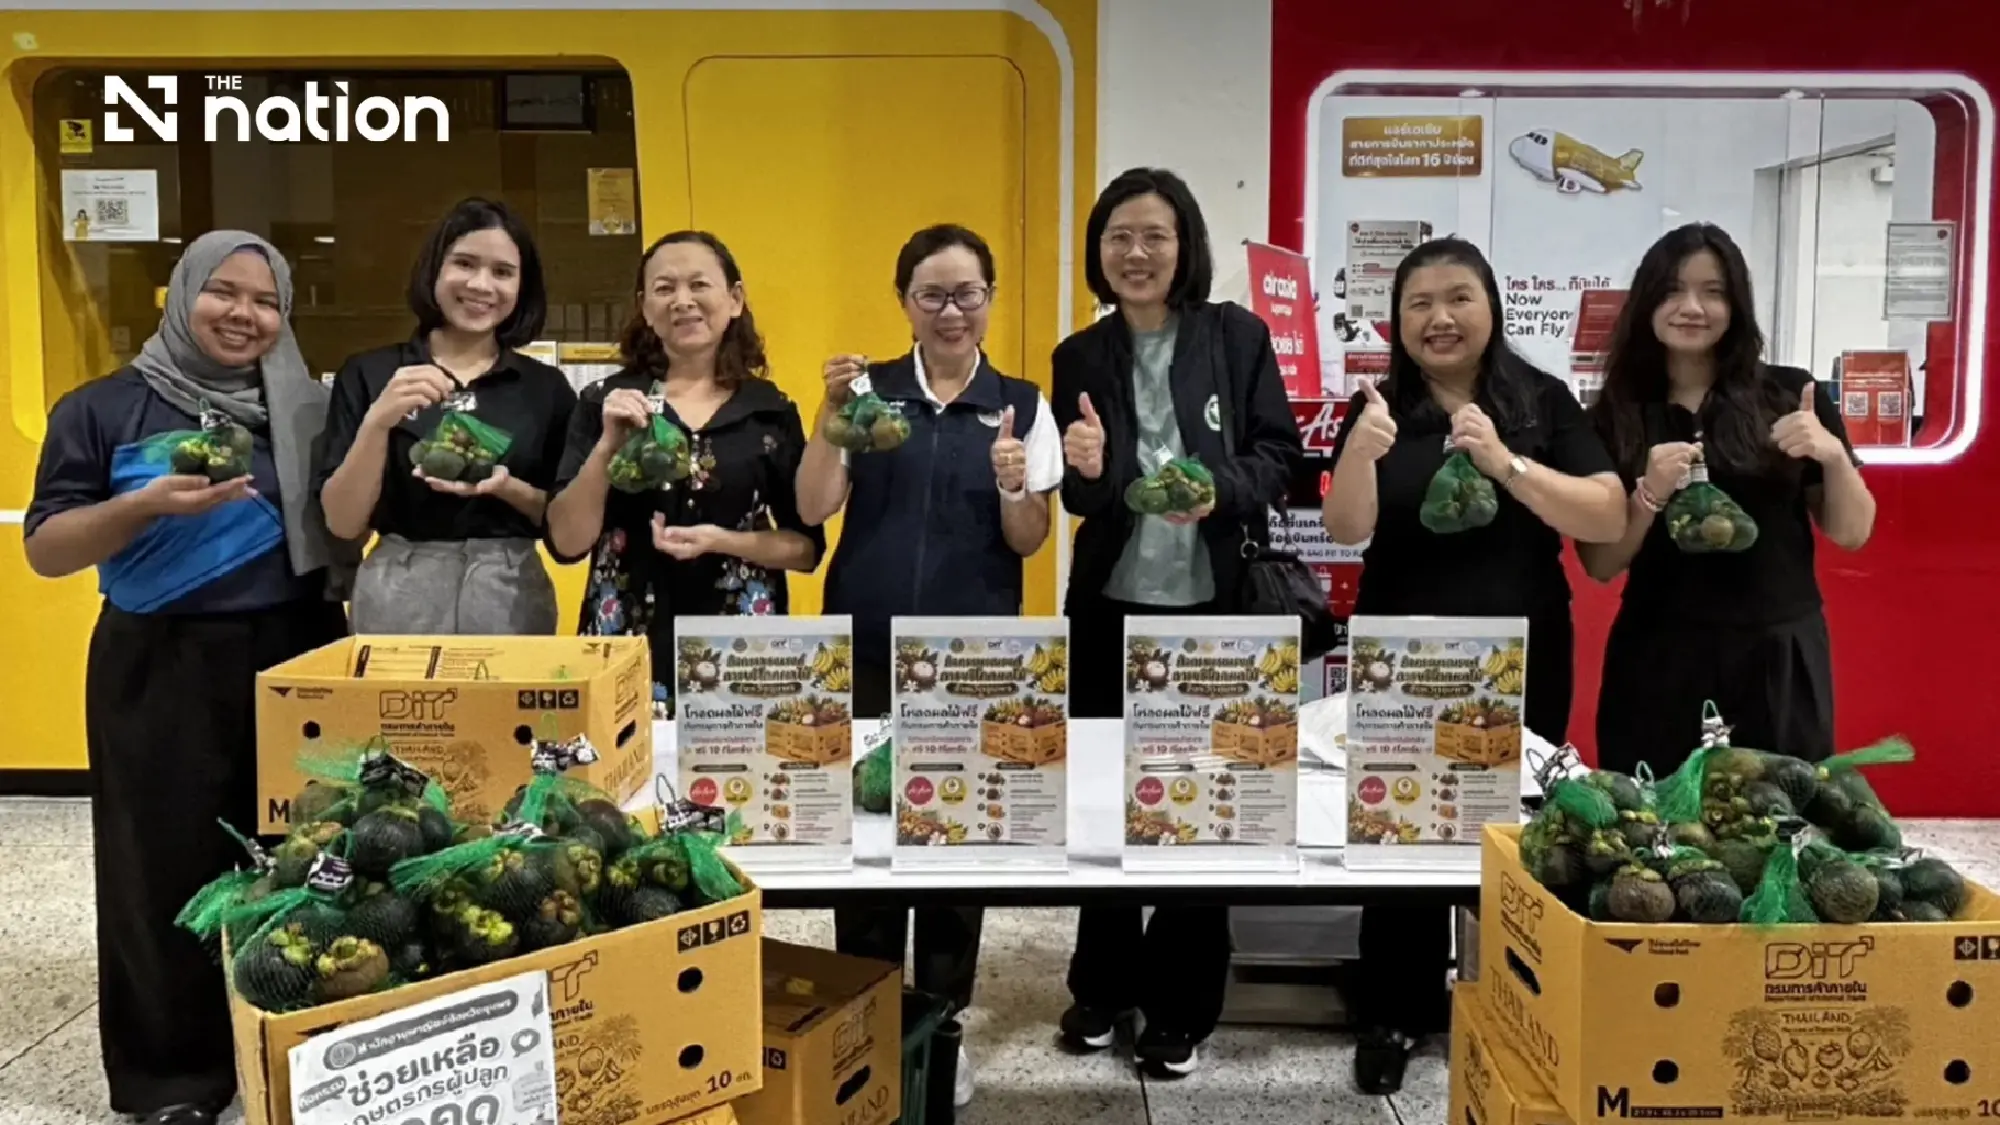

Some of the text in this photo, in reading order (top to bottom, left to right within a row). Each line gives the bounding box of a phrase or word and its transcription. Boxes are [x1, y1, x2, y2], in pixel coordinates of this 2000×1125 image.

[1422, 153, 1441, 167] 16
[1506, 293, 1542, 305] Now
[1506, 322, 1565, 338] Can Fly
[269, 800, 291, 823] M
[1781, 1013, 1850, 1024] THAILAND
[347, 1032, 501, 1106] ช่วยเหลือ
[706, 1069, 733, 1094] 10
[350, 1064, 509, 1125] กษตรกรผู้ปลูก
[1597, 1085, 1631, 1118] M
